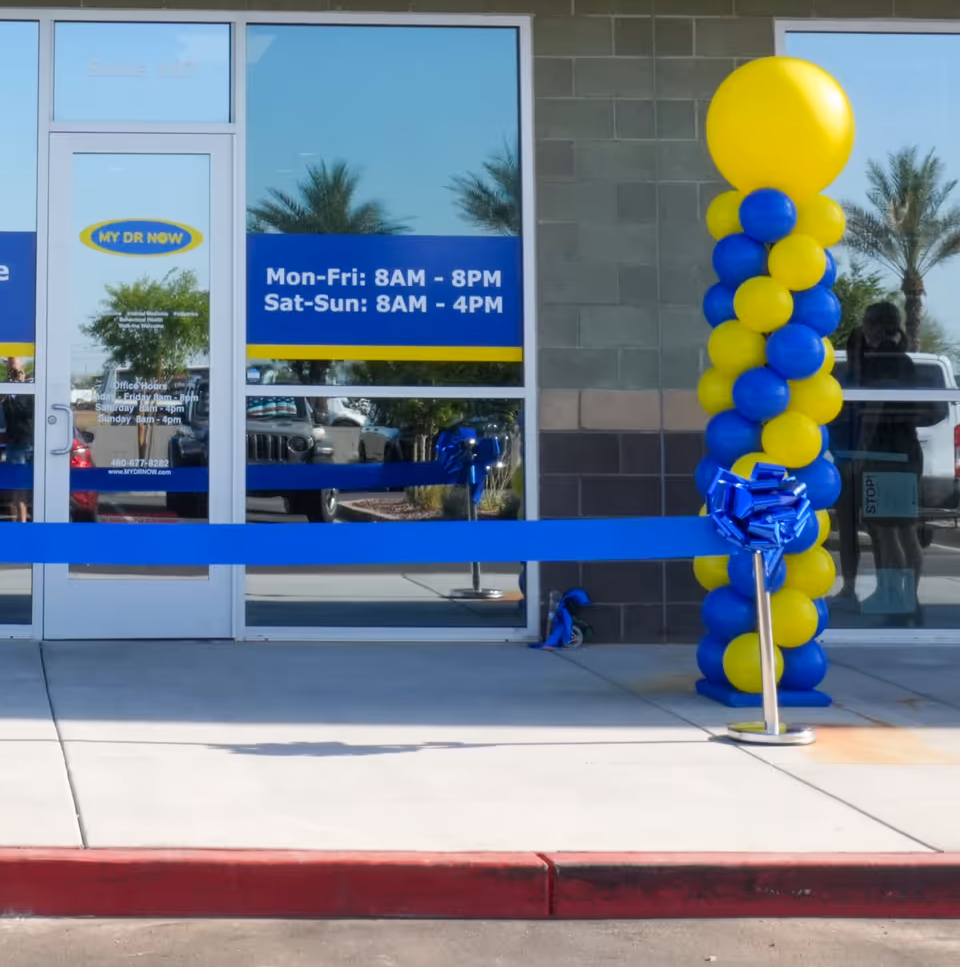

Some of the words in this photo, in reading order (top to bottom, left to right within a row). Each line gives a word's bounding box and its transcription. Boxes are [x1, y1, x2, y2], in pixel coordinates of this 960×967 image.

[99, 231, 120, 243] MY
[123, 231, 144, 243] DR
[147, 232, 183, 244] NOW
[265, 268, 367, 286] Mon-Fri:
[374, 269, 426, 287] 8AM
[451, 270, 502, 288] 8PM
[264, 293, 368, 312] Sat-Sun:
[376, 295, 428, 313] 8AM
[453, 295, 504, 314] 4PM
[113, 379, 139, 390] Office
[141, 380, 168, 391] Hours
[124, 392, 152, 404] Friday
[153, 393, 172, 402] 8am
[180, 394, 199, 405] 8pm
[95, 403, 134, 414] Saturday
[139, 404, 158, 412] 8am
[165, 405, 185, 415] 4pm
[97, 414, 131, 426] Sunday
[136, 415, 155, 424] 8am
[162, 415, 182, 426] 4pm
